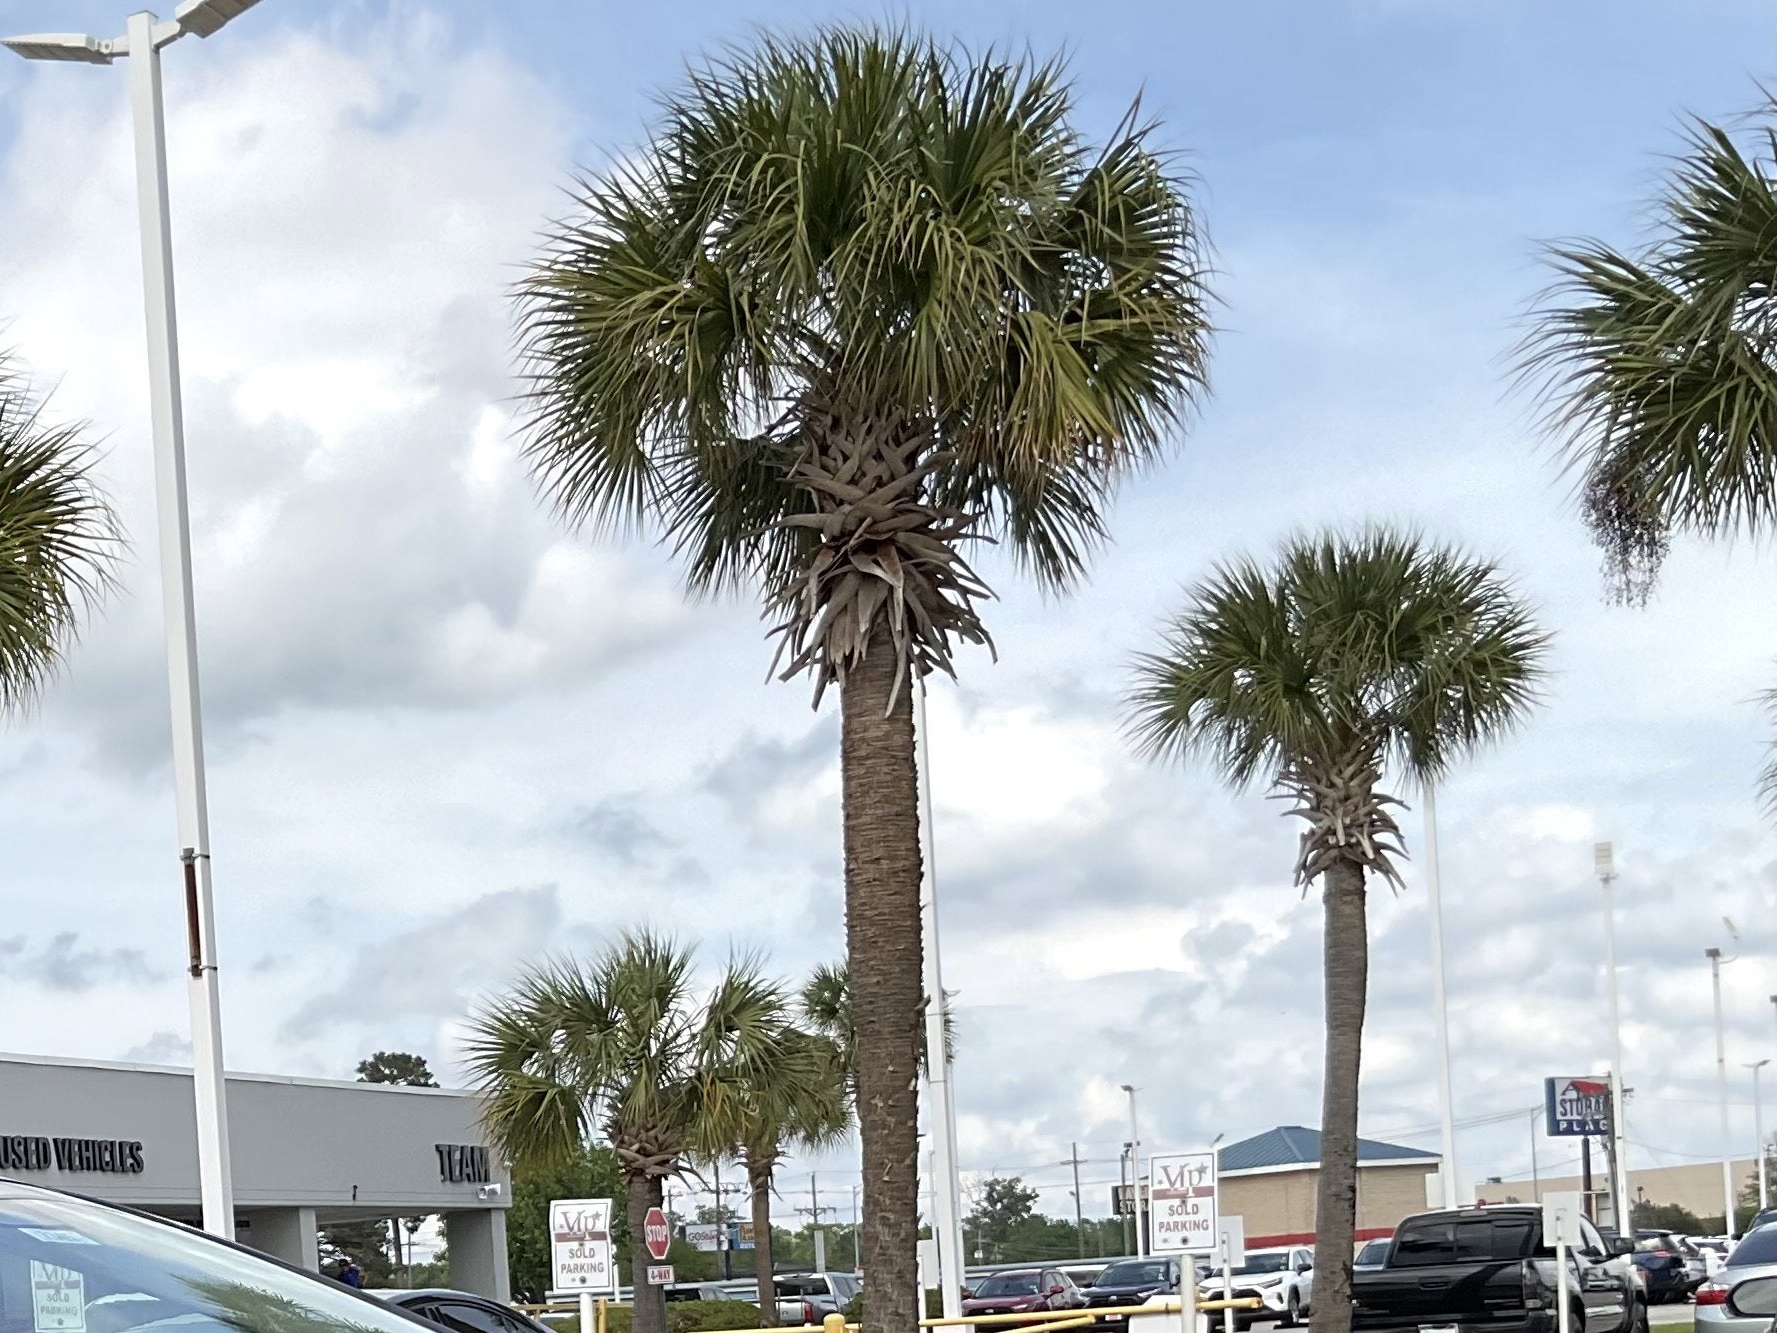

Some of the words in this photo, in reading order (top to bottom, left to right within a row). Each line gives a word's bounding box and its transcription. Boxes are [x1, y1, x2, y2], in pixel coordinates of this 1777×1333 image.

[1559, 1120, 1608, 1131] PLAC
[52, 1137, 144, 1173] VEHICLES
[434, 1143, 491, 1184] TEAM
[1168, 1203, 1199, 1217] SOLD
[1158, 1219, 1210, 1233] PARKING
[646, 1224, 667, 1242] STOP
[568, 1247, 596, 1259] SOLD
[560, 1262, 605, 1274] PARKING
[649, 1268, 671, 1281] 4-WAY
[46, 1292, 70, 1303] SOLD
[40, 1305, 78, 1316] PARKING
